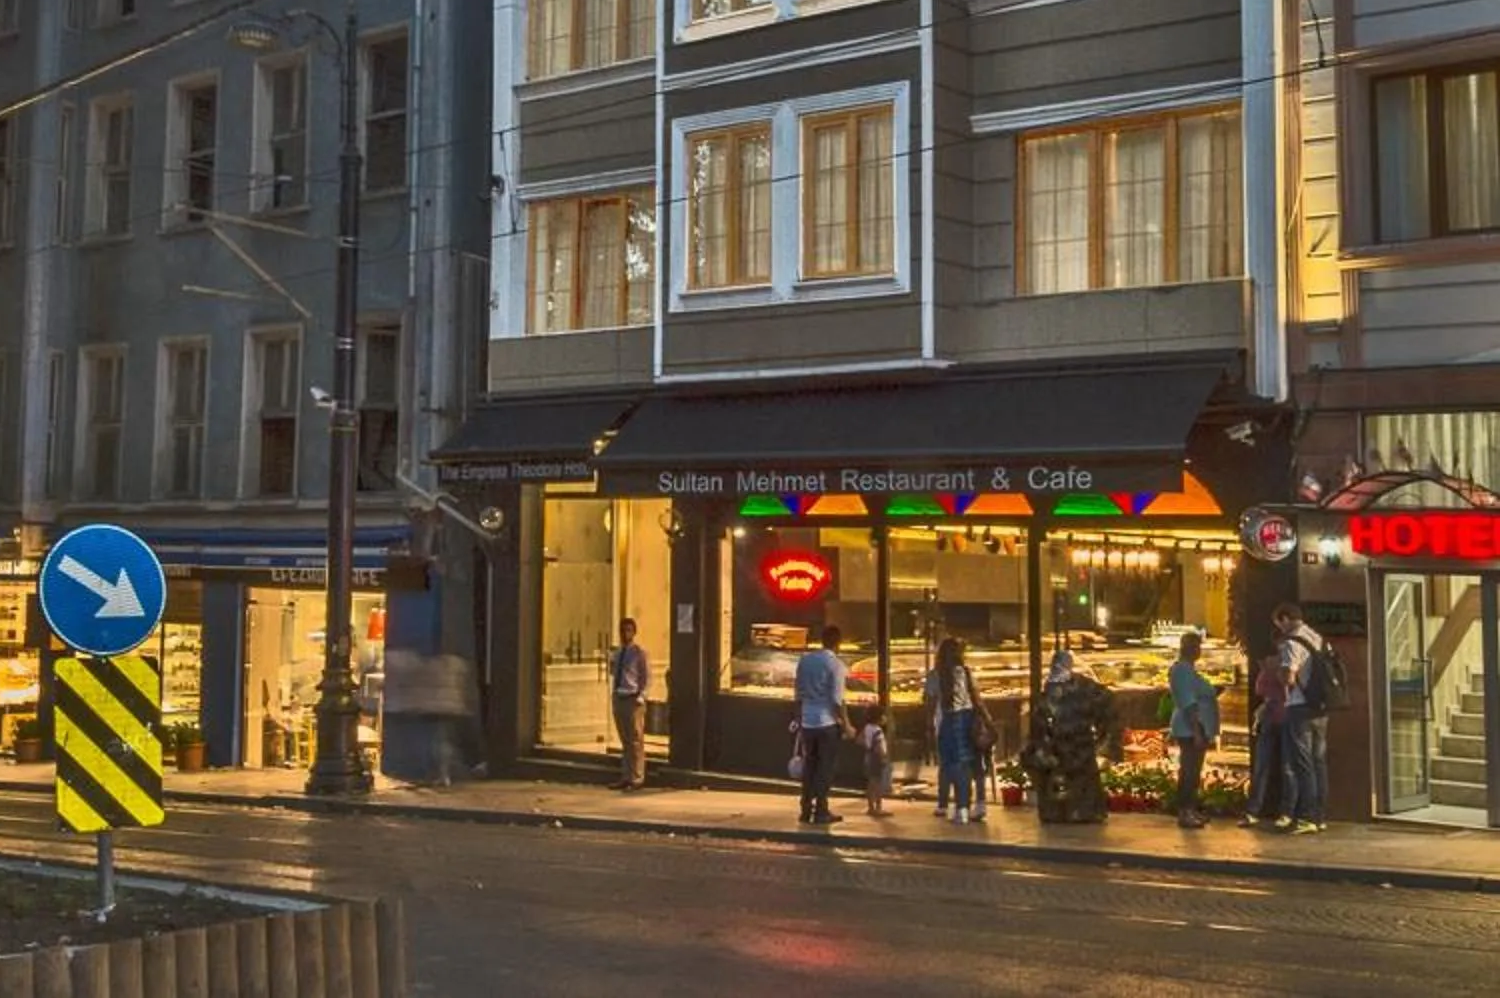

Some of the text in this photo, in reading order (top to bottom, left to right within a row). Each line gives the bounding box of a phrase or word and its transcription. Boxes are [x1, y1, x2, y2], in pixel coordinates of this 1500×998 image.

[658, 465, 1093, 493] Sultan Mehmet Restaurant & Cafe
[1350, 513, 1500, 558] HOTE
